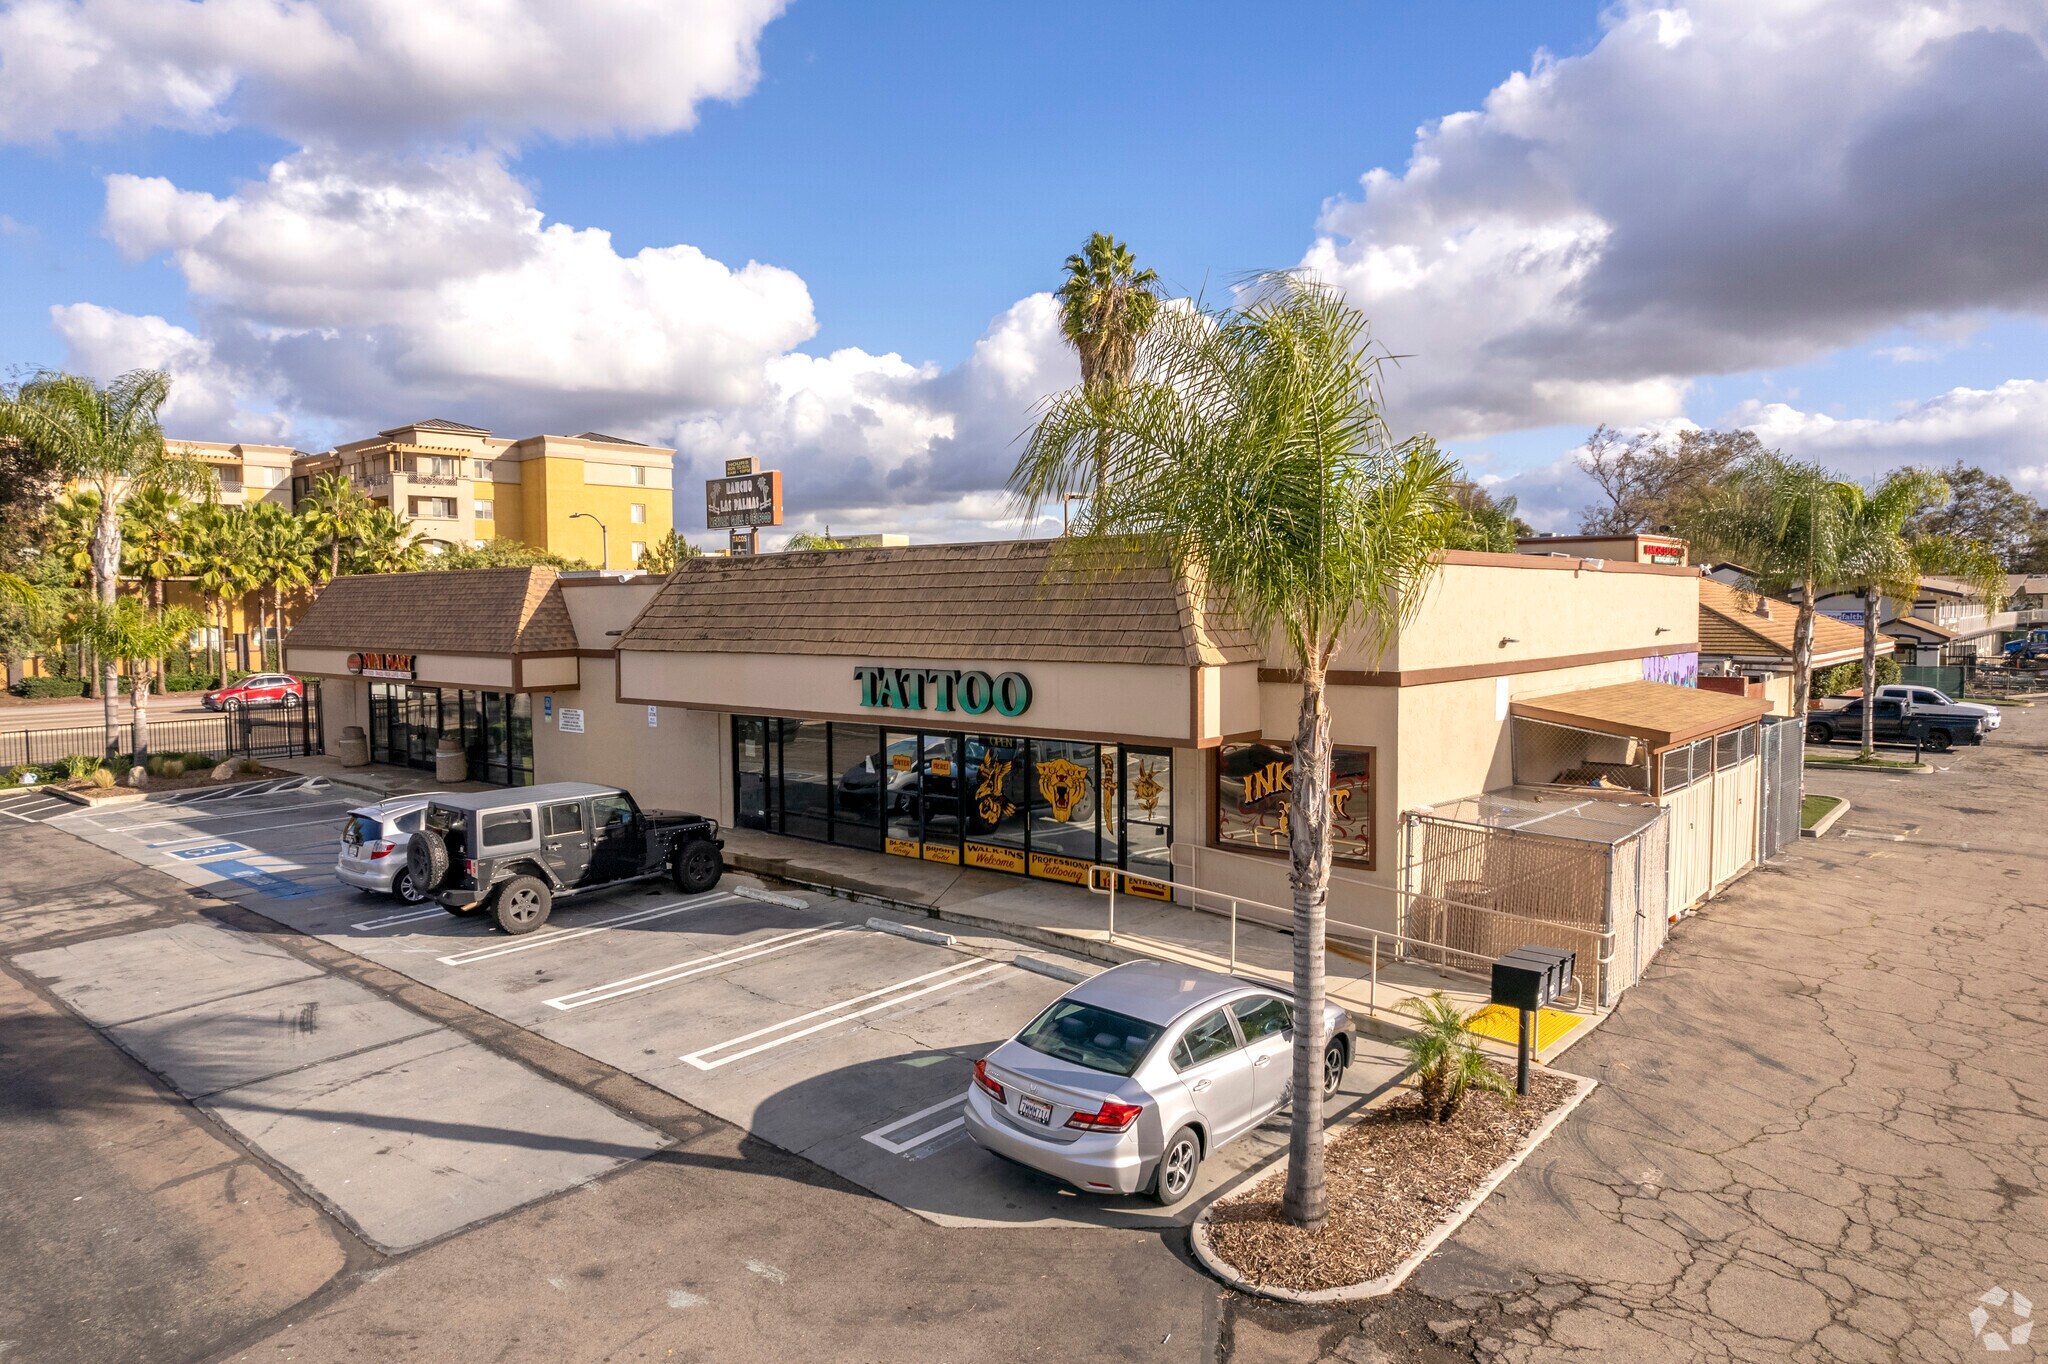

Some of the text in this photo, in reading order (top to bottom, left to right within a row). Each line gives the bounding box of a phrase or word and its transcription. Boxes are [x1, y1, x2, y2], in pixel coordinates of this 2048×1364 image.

[726, 480, 752, 494] RANCHO
[720, 496, 759, 512] LAS PALMAS
[363, 652, 384, 670] MINI
[386, 653, 411, 672] MART
[853, 666, 1033, 717] TATTOO
[989, 736, 1013, 748] OPEN
[894, 758, 910, 767] ENTER
[889, 840, 915, 849] BLACK
[926, 845, 956, 855] BRIGHT
[967, 844, 1024, 860] WALK-INS
[975, 853, 1015, 869] Welcome
[1042, 863, 1083, 883] Tattooing
[1129, 878, 1167, 890] ENTRANCE
